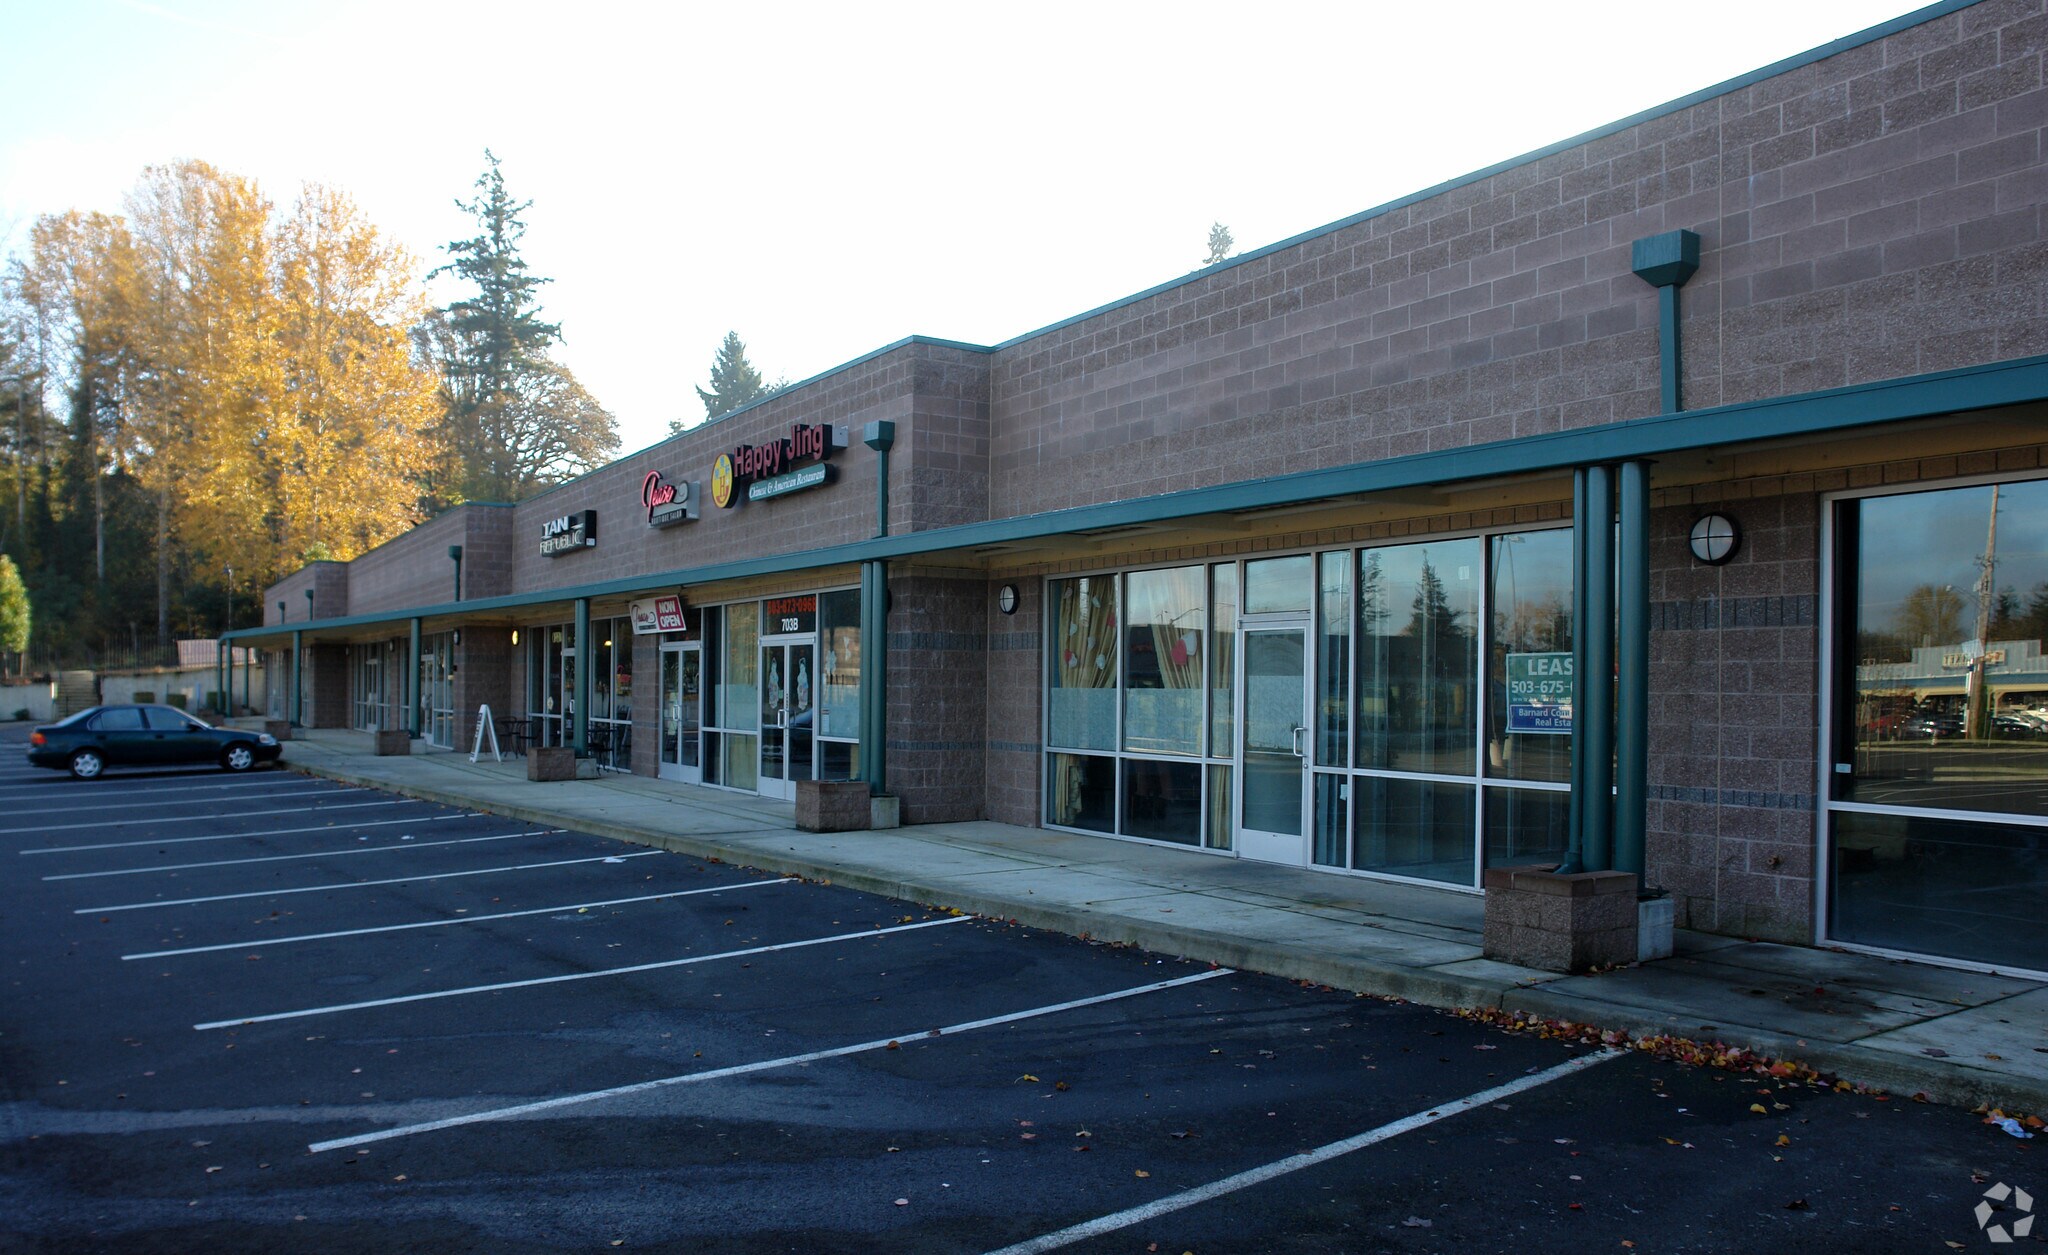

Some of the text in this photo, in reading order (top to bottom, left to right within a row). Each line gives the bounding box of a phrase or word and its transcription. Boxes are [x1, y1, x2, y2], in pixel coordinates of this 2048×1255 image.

[734, 424, 824, 479] Happy Jing
[773, 478, 797, 492] American
[797, 469, 825, 486] Restaurant
[542, 515, 569, 537] TAN
[540, 529, 583, 554] REPUBLIC
[658, 600, 676, 614] NOW
[660, 614, 681, 628] OPEN
[781, 617, 799, 632] 703B
[1527, 658, 1573, 676] LEAS
[1511, 680, 1572, 694] 503-675-
[1518, 708, 1548, 717] Barnard
[1535, 718, 1552, 727] Real
